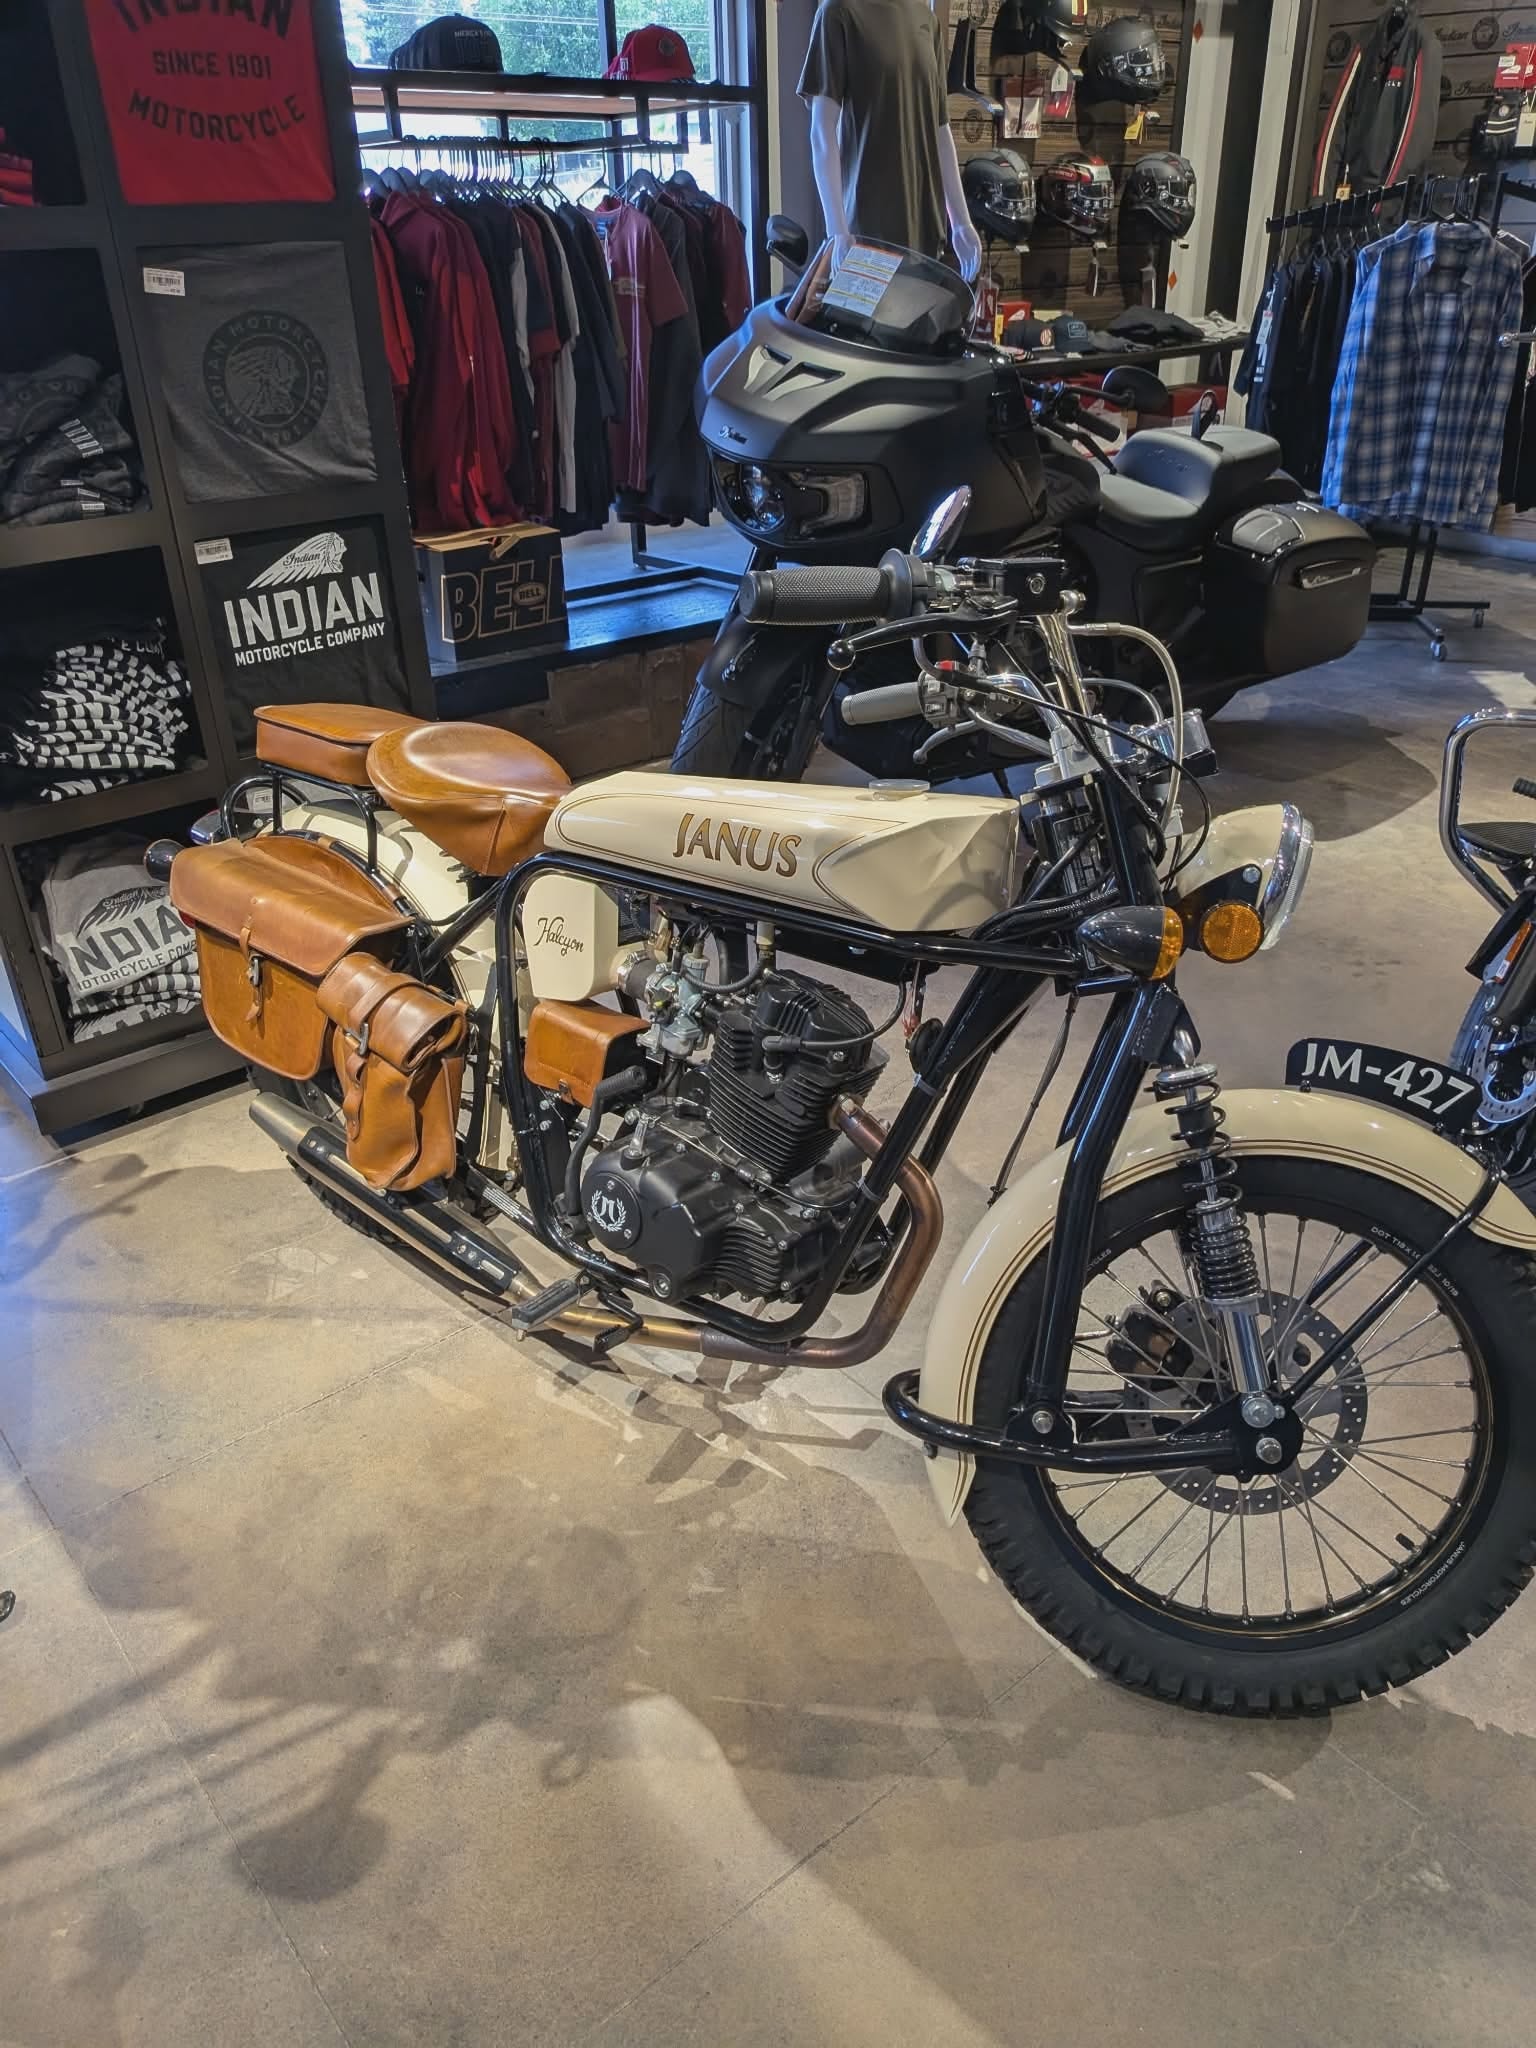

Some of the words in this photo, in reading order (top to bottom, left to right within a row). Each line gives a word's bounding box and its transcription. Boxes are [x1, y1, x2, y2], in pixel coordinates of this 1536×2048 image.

[152, 50, 220, 77] SINCE
[228, 53, 272, 80] 1901
[127, 89, 305, 143] MOTORCYCLE
[282, 552, 321, 567] Indian
[224, 572, 384, 648] INDIAN
[519, 587, 542, 600] BELL
[234, 636, 324, 667] MOTORCYCLE
[326, 622, 385, 647] COMPANY
[672, 812, 802, 877] JANUS
[70, 904, 191, 977] NDIA
[169, 940, 196, 962] COMP
[533, 916, 584, 957] Halcyon
[1301, 1043, 1475, 1115] JM-427
[1371, 1226, 1391, 1239] DOT
[1446, 1541, 1466, 1565] JANUS
[1400, 1563, 1449, 1606] MOTORCYCLES
